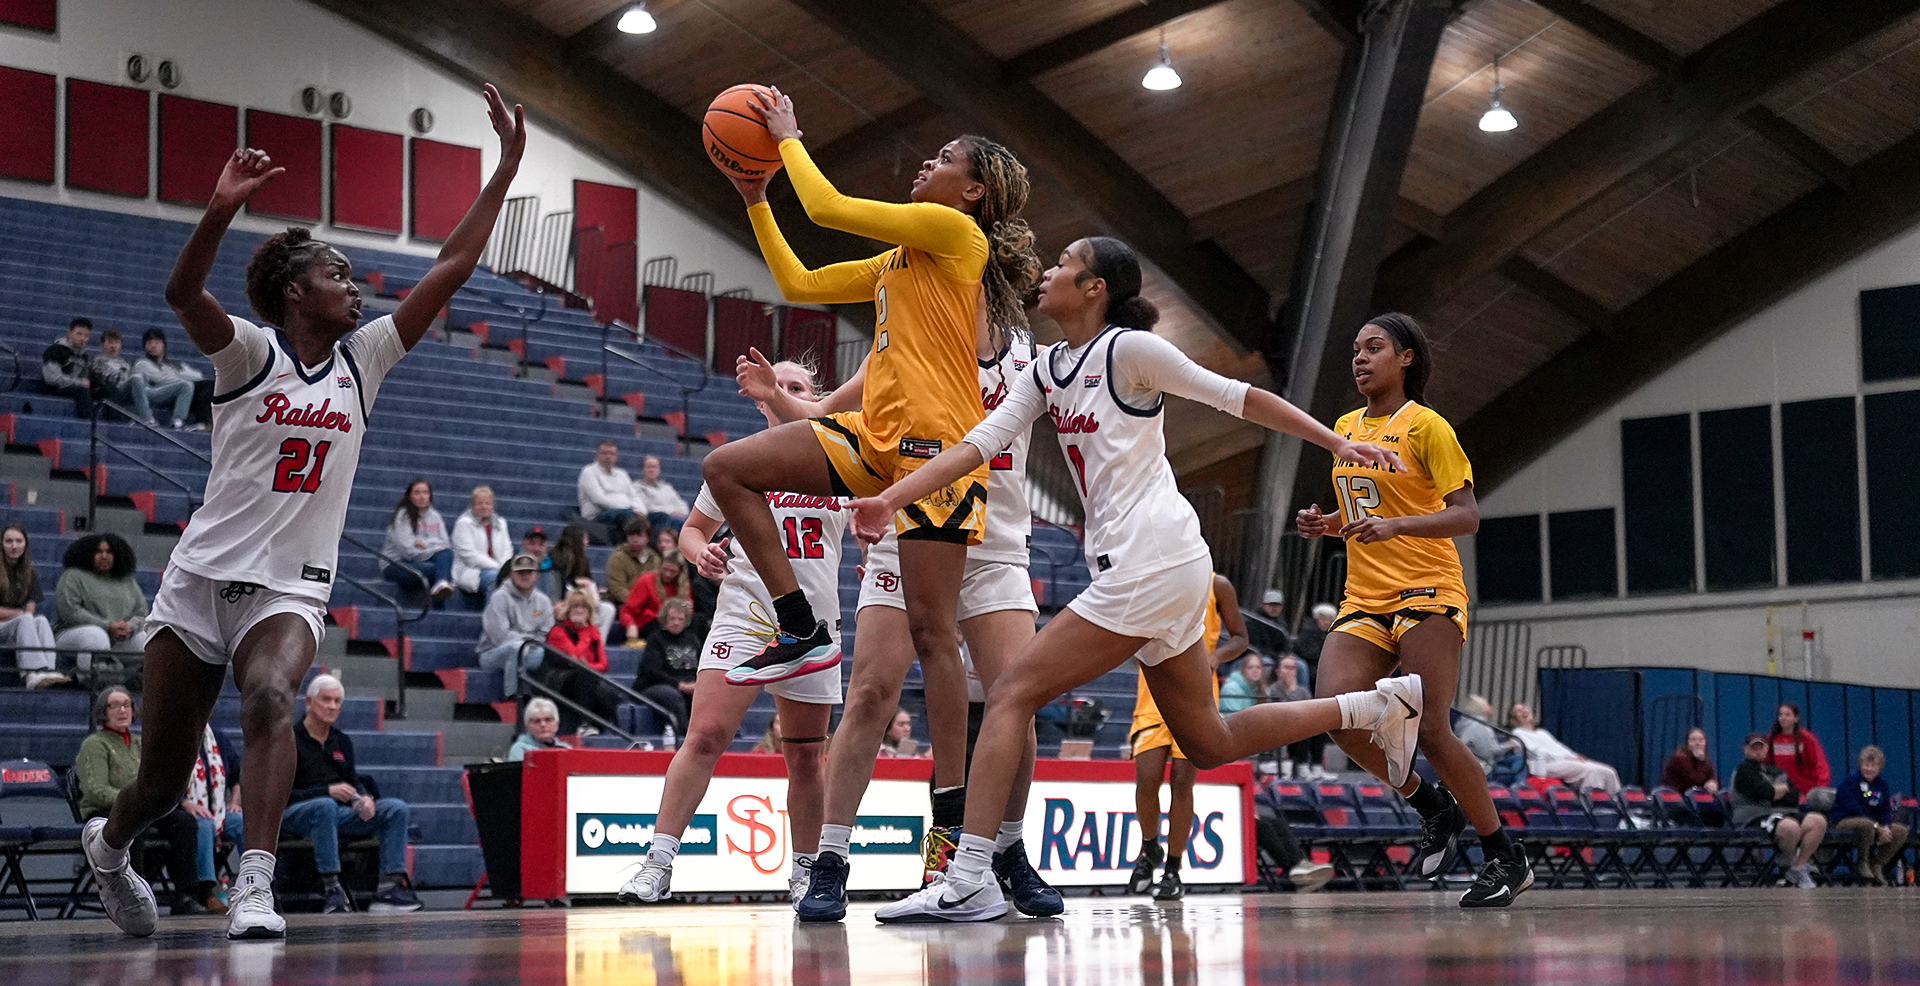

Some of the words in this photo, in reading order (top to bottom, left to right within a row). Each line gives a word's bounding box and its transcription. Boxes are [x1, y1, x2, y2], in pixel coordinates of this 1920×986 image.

[711, 141, 766, 176] Wilson
[256, 393, 352, 433] Raiders
[272, 437, 332, 494] 21
[1336, 476, 1381, 524] 12
[782, 516, 824, 559] 12
[875, 571, 901, 592] SU
[711, 641, 734, 660] SU
[725, 794, 788, 875] SU
